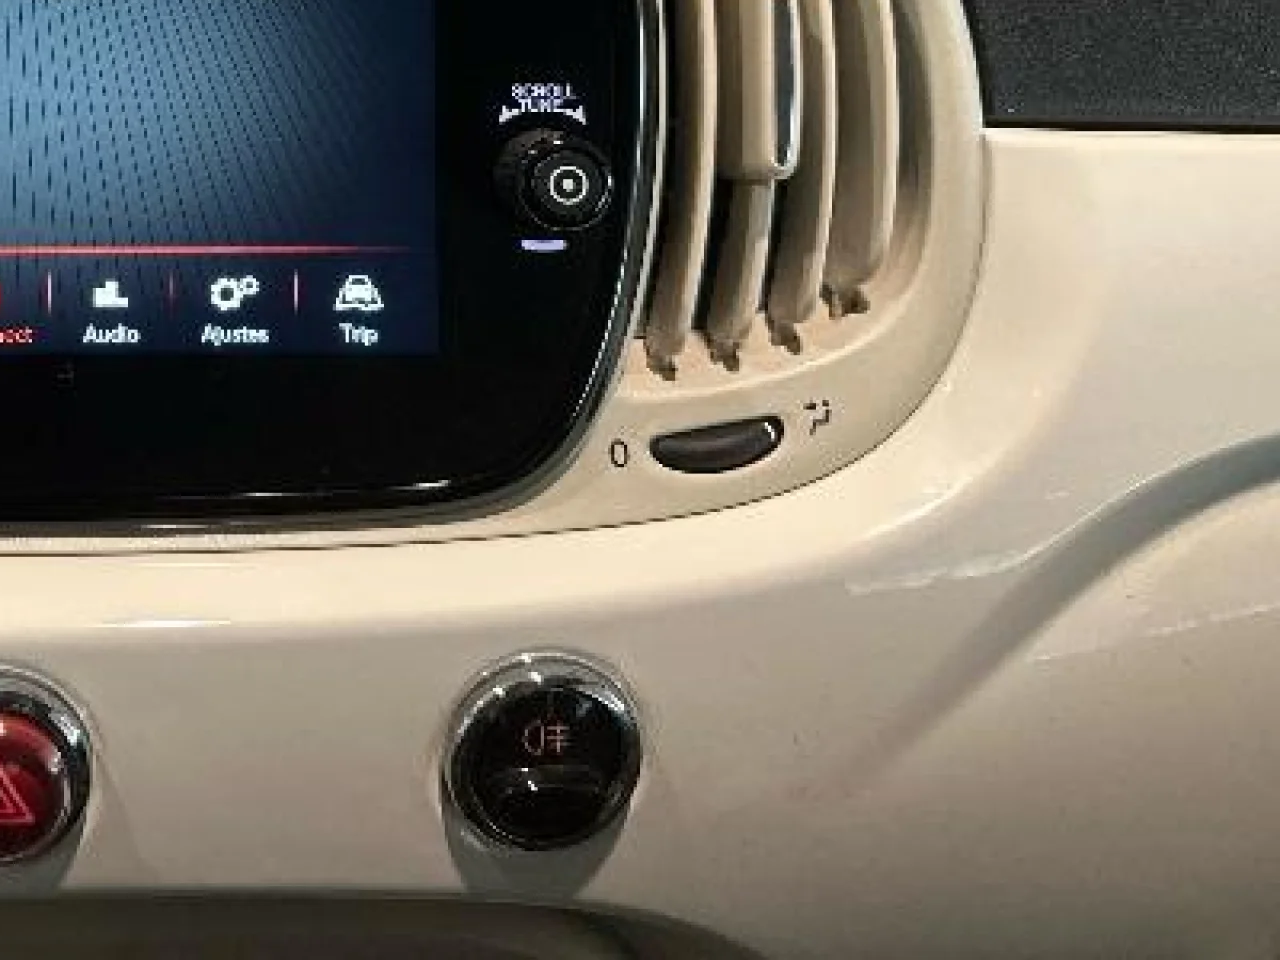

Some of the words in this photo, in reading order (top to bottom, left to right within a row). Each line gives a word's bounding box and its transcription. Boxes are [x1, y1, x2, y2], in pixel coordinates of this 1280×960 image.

[82, 324, 141, 345] Audio
[201, 324, 270, 347] Ajustes
[338, 323, 380, 346] Trip
